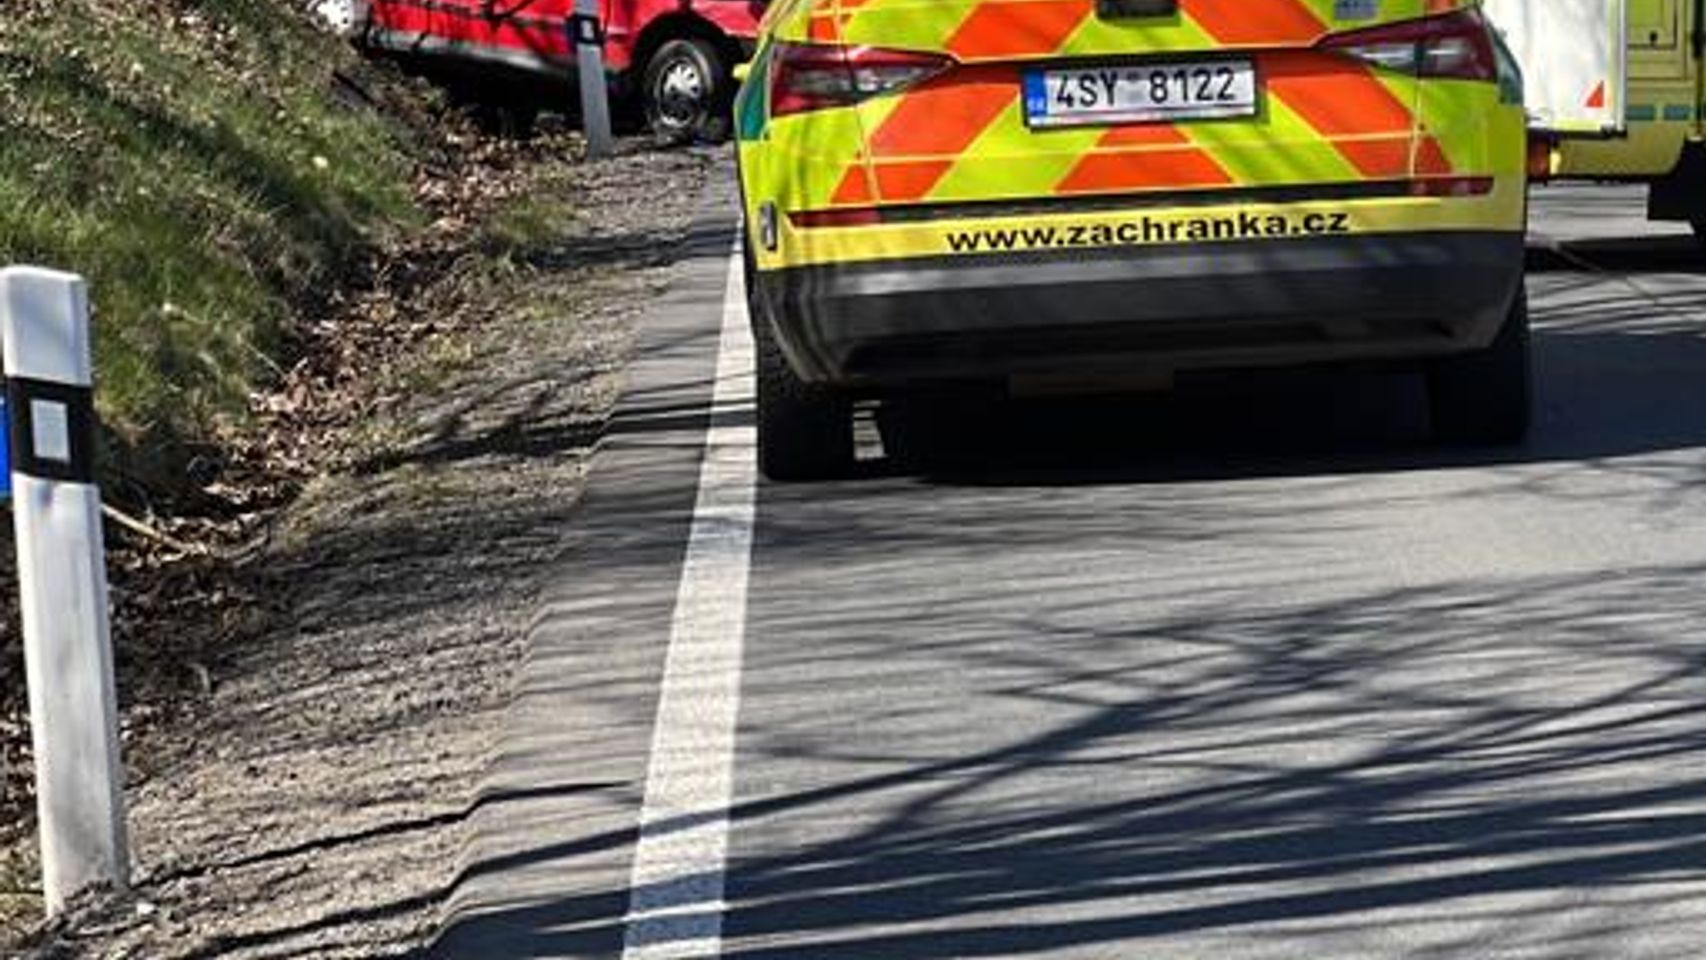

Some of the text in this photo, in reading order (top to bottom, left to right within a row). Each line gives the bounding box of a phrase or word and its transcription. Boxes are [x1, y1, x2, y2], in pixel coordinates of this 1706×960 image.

[1056, 70, 1119, 109] 4SY
[1149, 66, 1235, 105] 8122
[946, 211, 1350, 252] www.zachranka.cz
